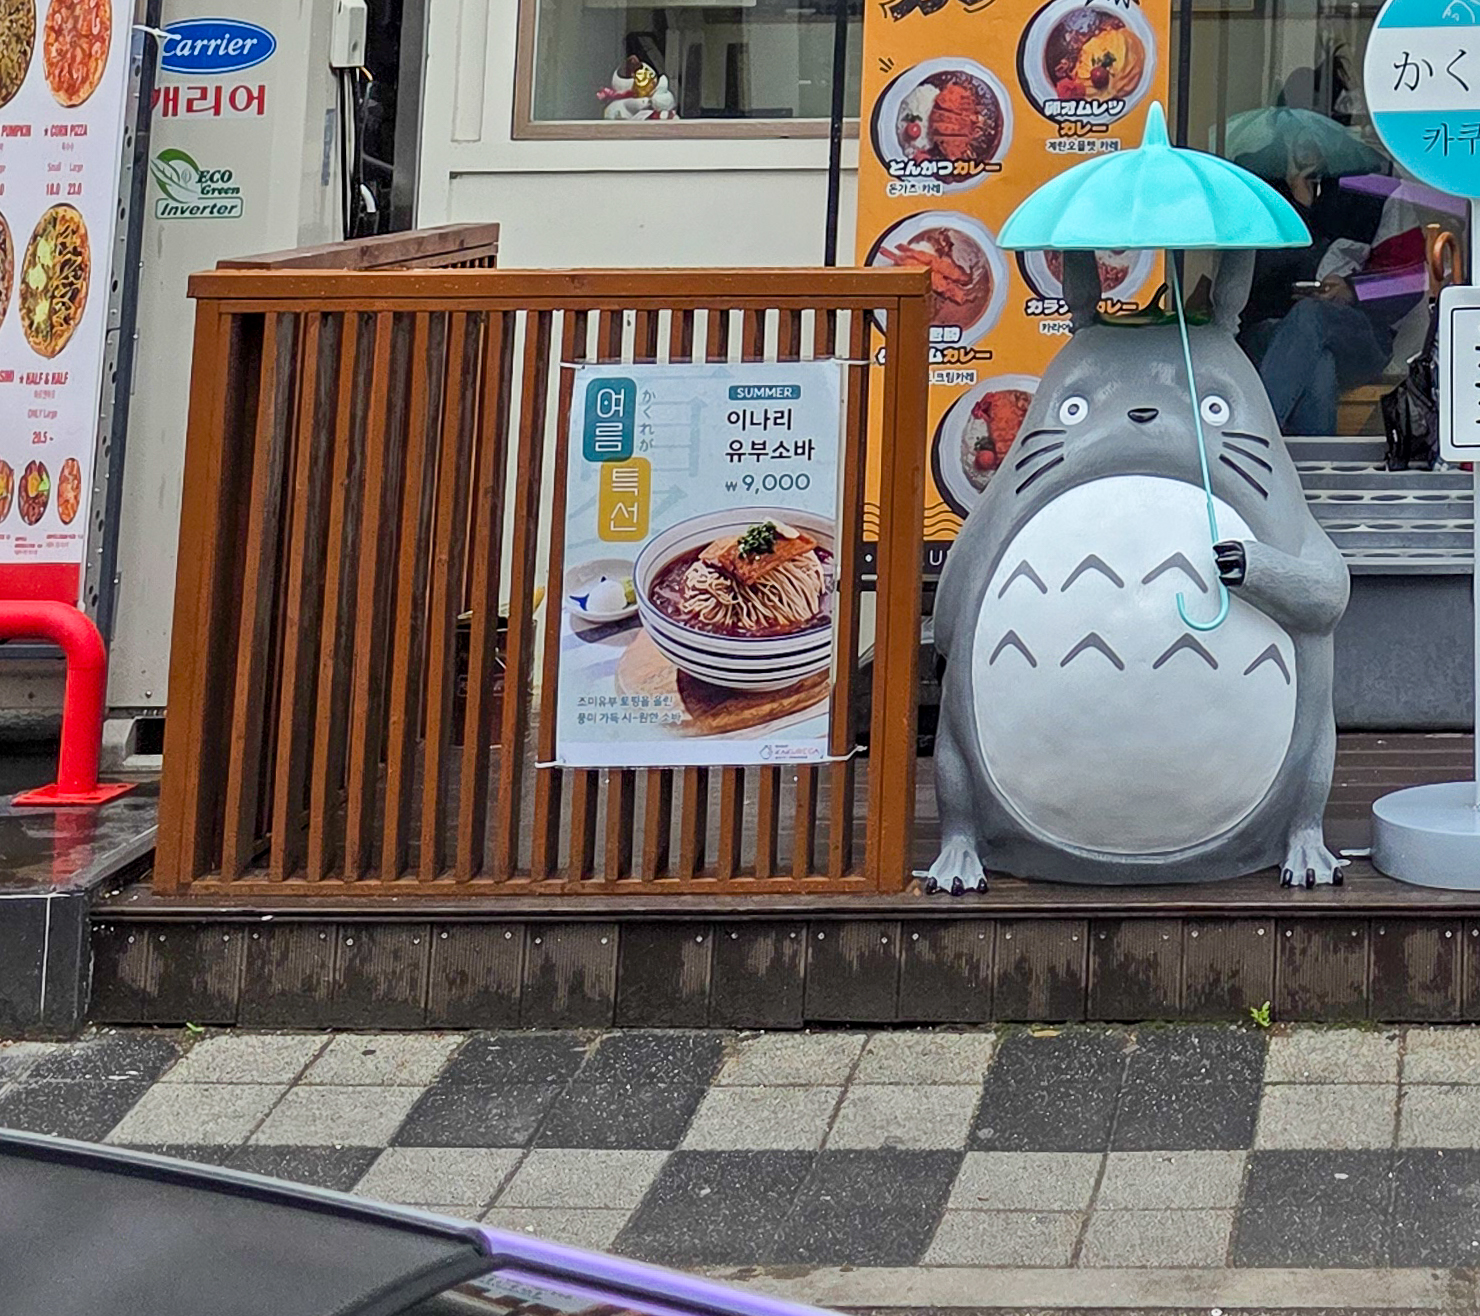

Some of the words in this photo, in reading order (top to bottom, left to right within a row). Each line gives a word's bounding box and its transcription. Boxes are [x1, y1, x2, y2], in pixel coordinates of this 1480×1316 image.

[161, 33, 258, 58] Carrier
[1060, 121, 1107, 136] カレー
[197, 169, 233, 184] ECO
[889, 160, 1000, 176] とんかつカレー
[200, 184, 240, 196] Green
[160, 203, 238, 217] Inverter
[736, 387, 792, 398] SUMMER
[595, 387, 625, 453] 여름
[638, 389, 657, 453] かくれが
[726, 408, 793, 432] 이나리
[725, 438, 816, 463] 유부소바
[610, 467, 639, 532] 특선
